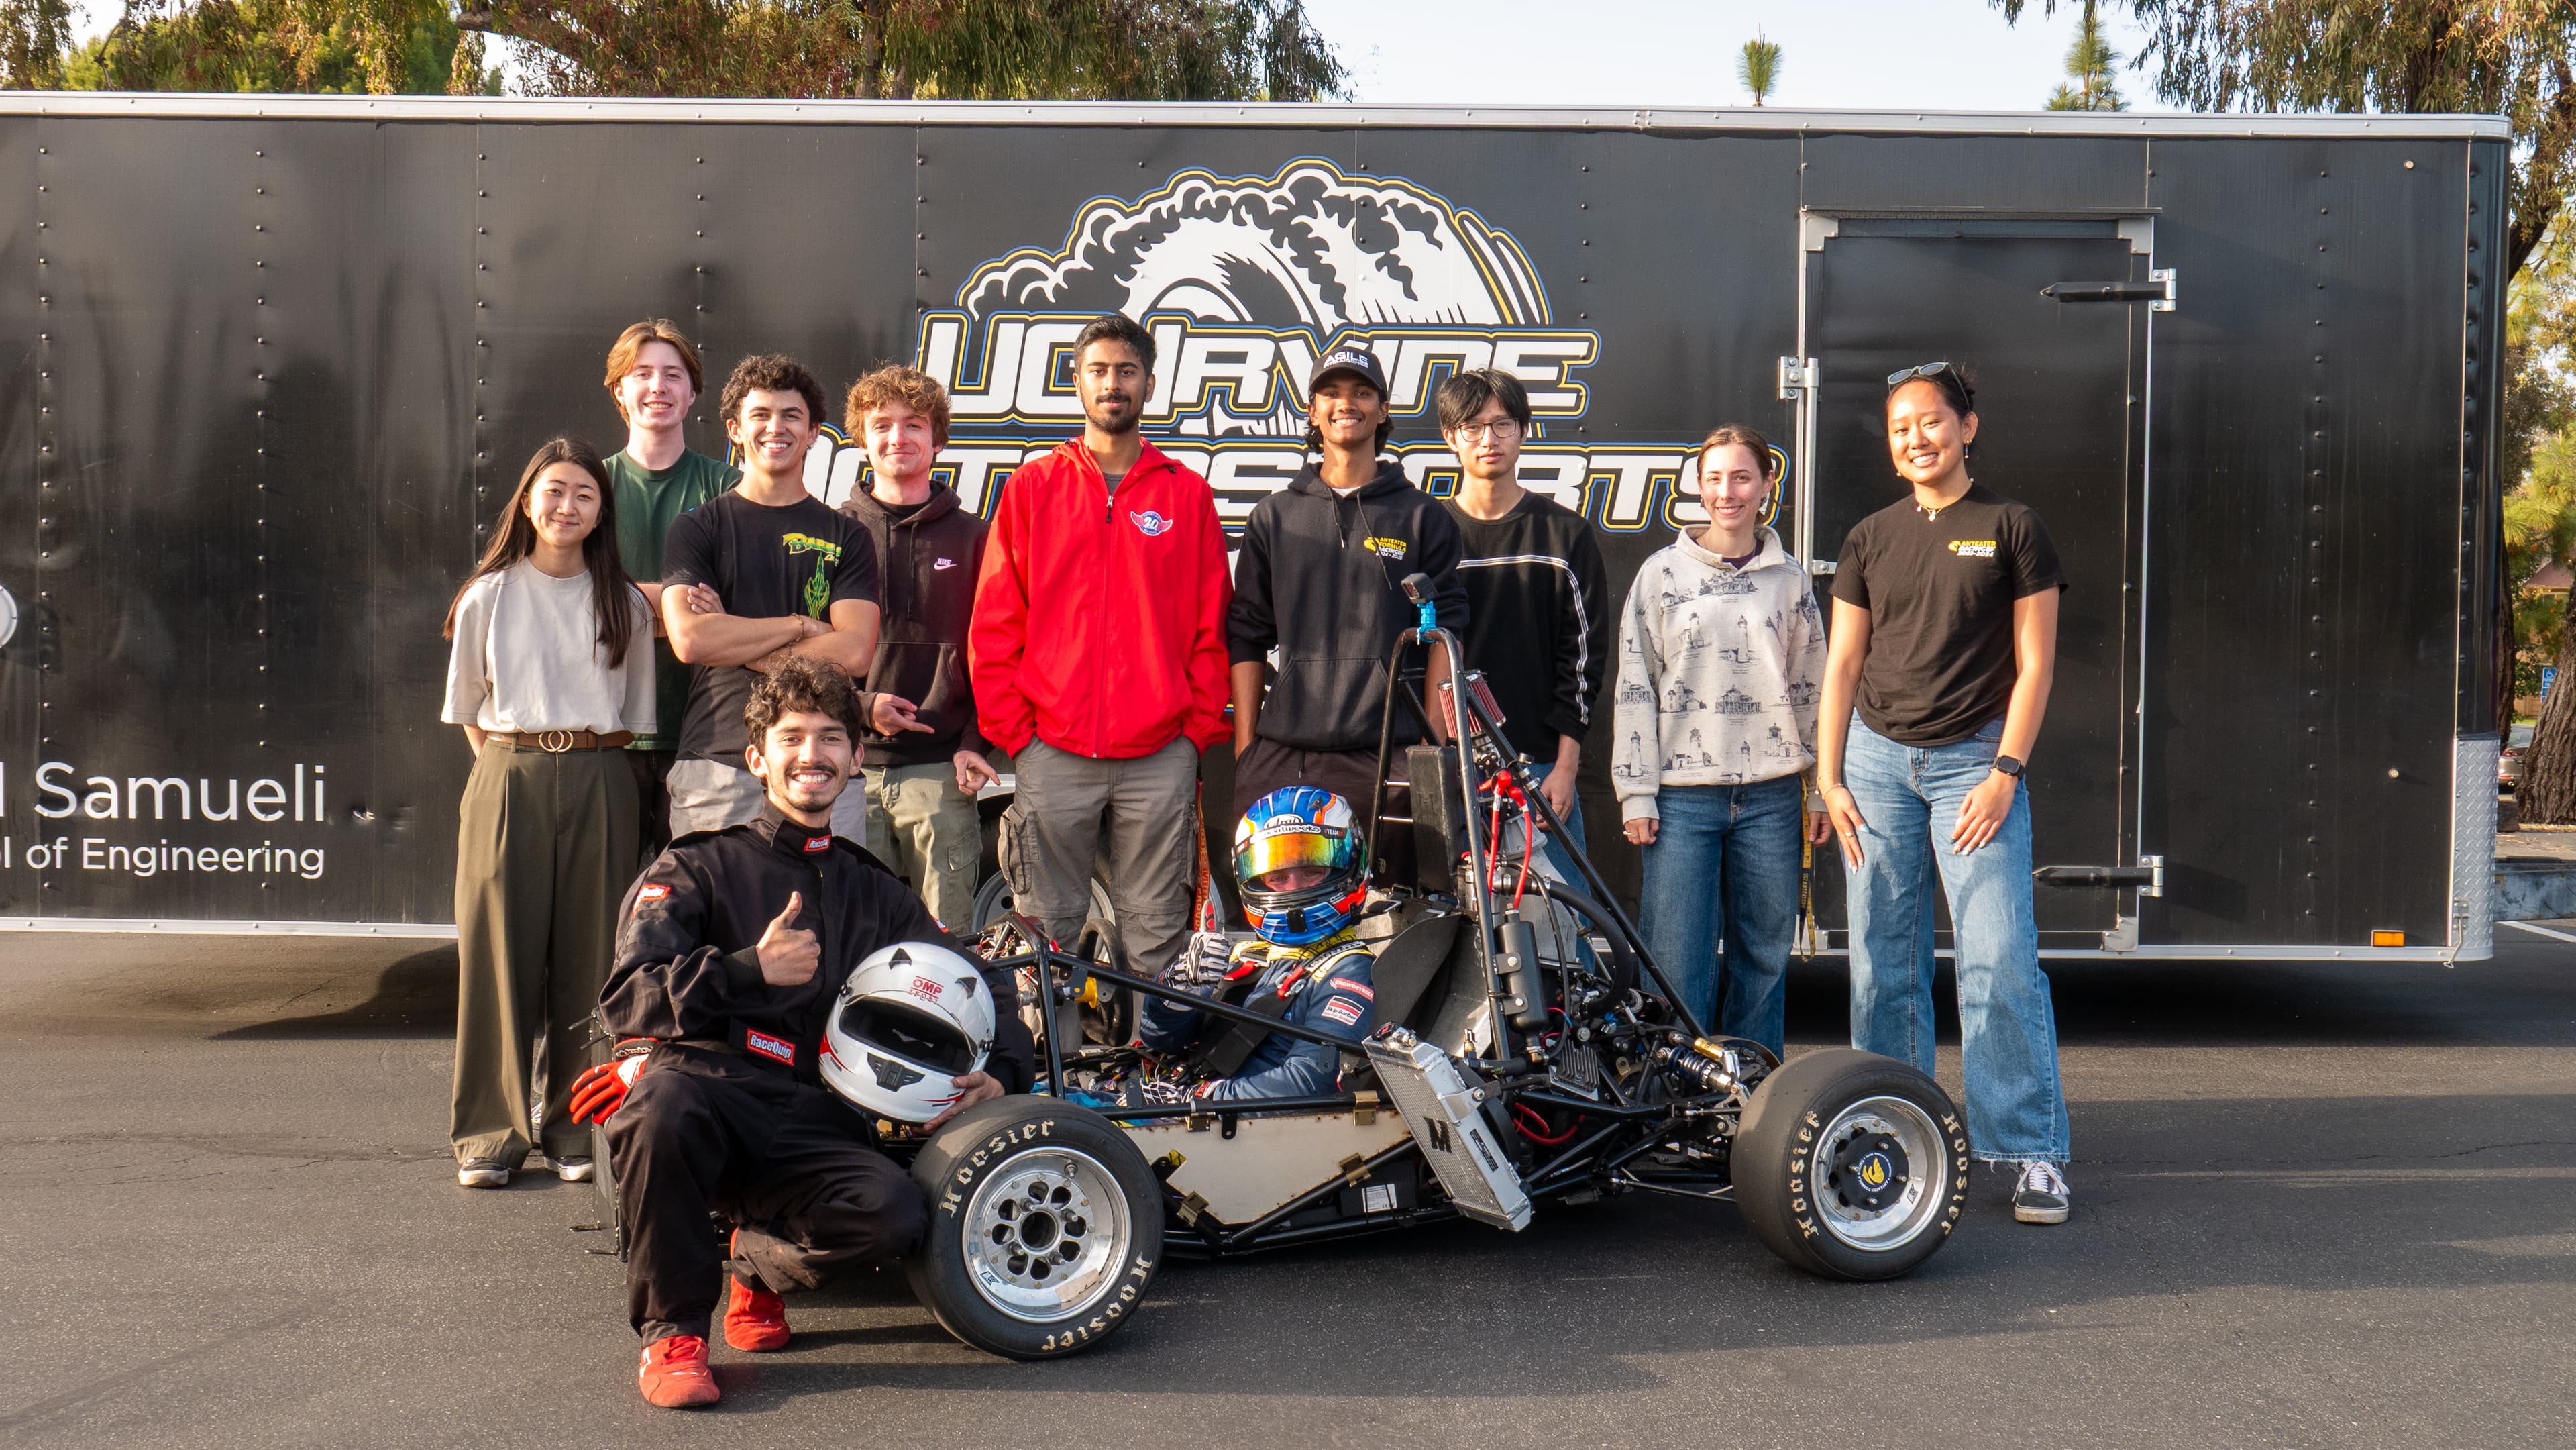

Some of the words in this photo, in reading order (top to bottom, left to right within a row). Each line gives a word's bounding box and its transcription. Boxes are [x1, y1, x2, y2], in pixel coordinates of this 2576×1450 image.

[1325, 351, 1368, 364] AGILE
[1379, 541, 1407, 552] FORMULA
[1380, 537, 1407, 547] ANTEATER
[34, 762, 325, 821] Samueli
[26, 837, 68, 869] of
[83, 837, 325, 880] Engineering
[912, 979, 943, 995] OMP
[750, 1034, 792, 1059] RaceQuip
[939, 1119, 1055, 1219] Hoosier
[1789, 1110, 1820, 1239] Hoosier
[1941, 1111, 1968, 1235] Hoosier
[1042, 1251, 1153, 1351] Hoosier
